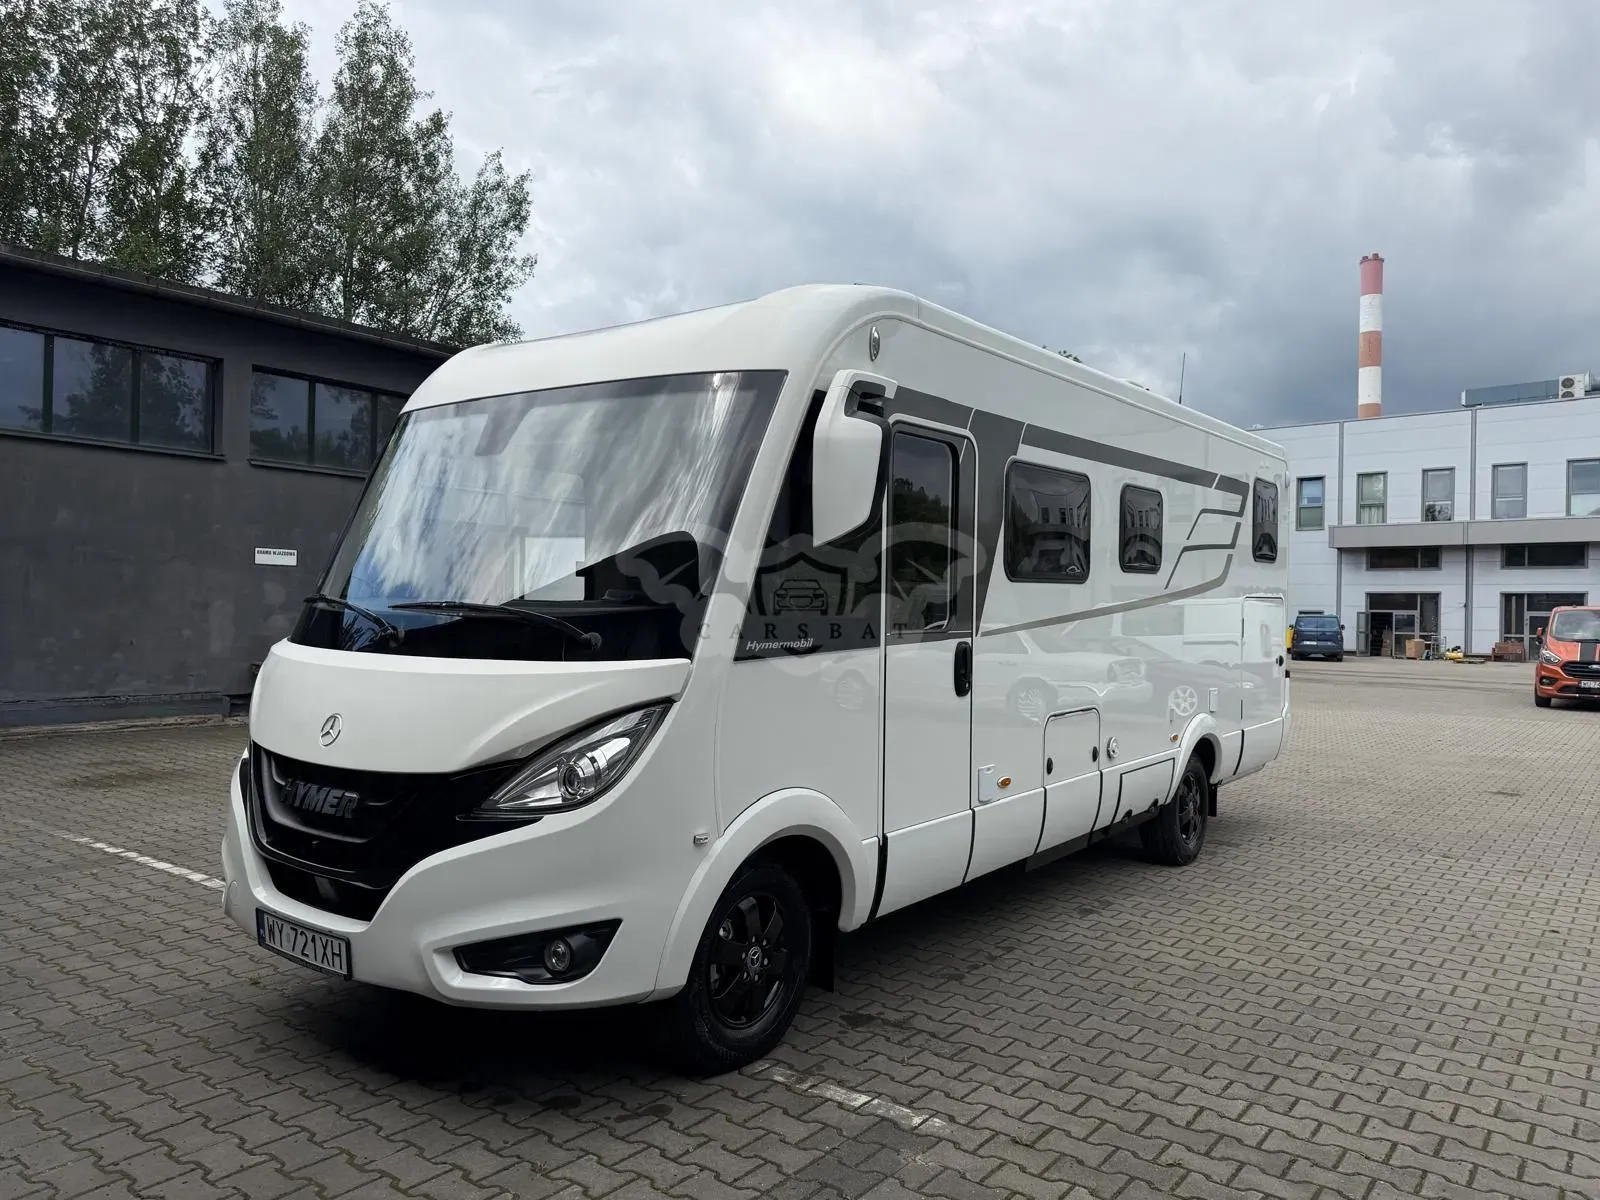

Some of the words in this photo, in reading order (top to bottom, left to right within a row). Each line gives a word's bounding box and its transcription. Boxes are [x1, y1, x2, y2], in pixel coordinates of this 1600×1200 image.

[746, 637, 814, 652] Hymermobil
[280, 779, 359, 819] HYMER
[266, 916, 284, 948] WY
[290, 926, 343, 970] 721XH
